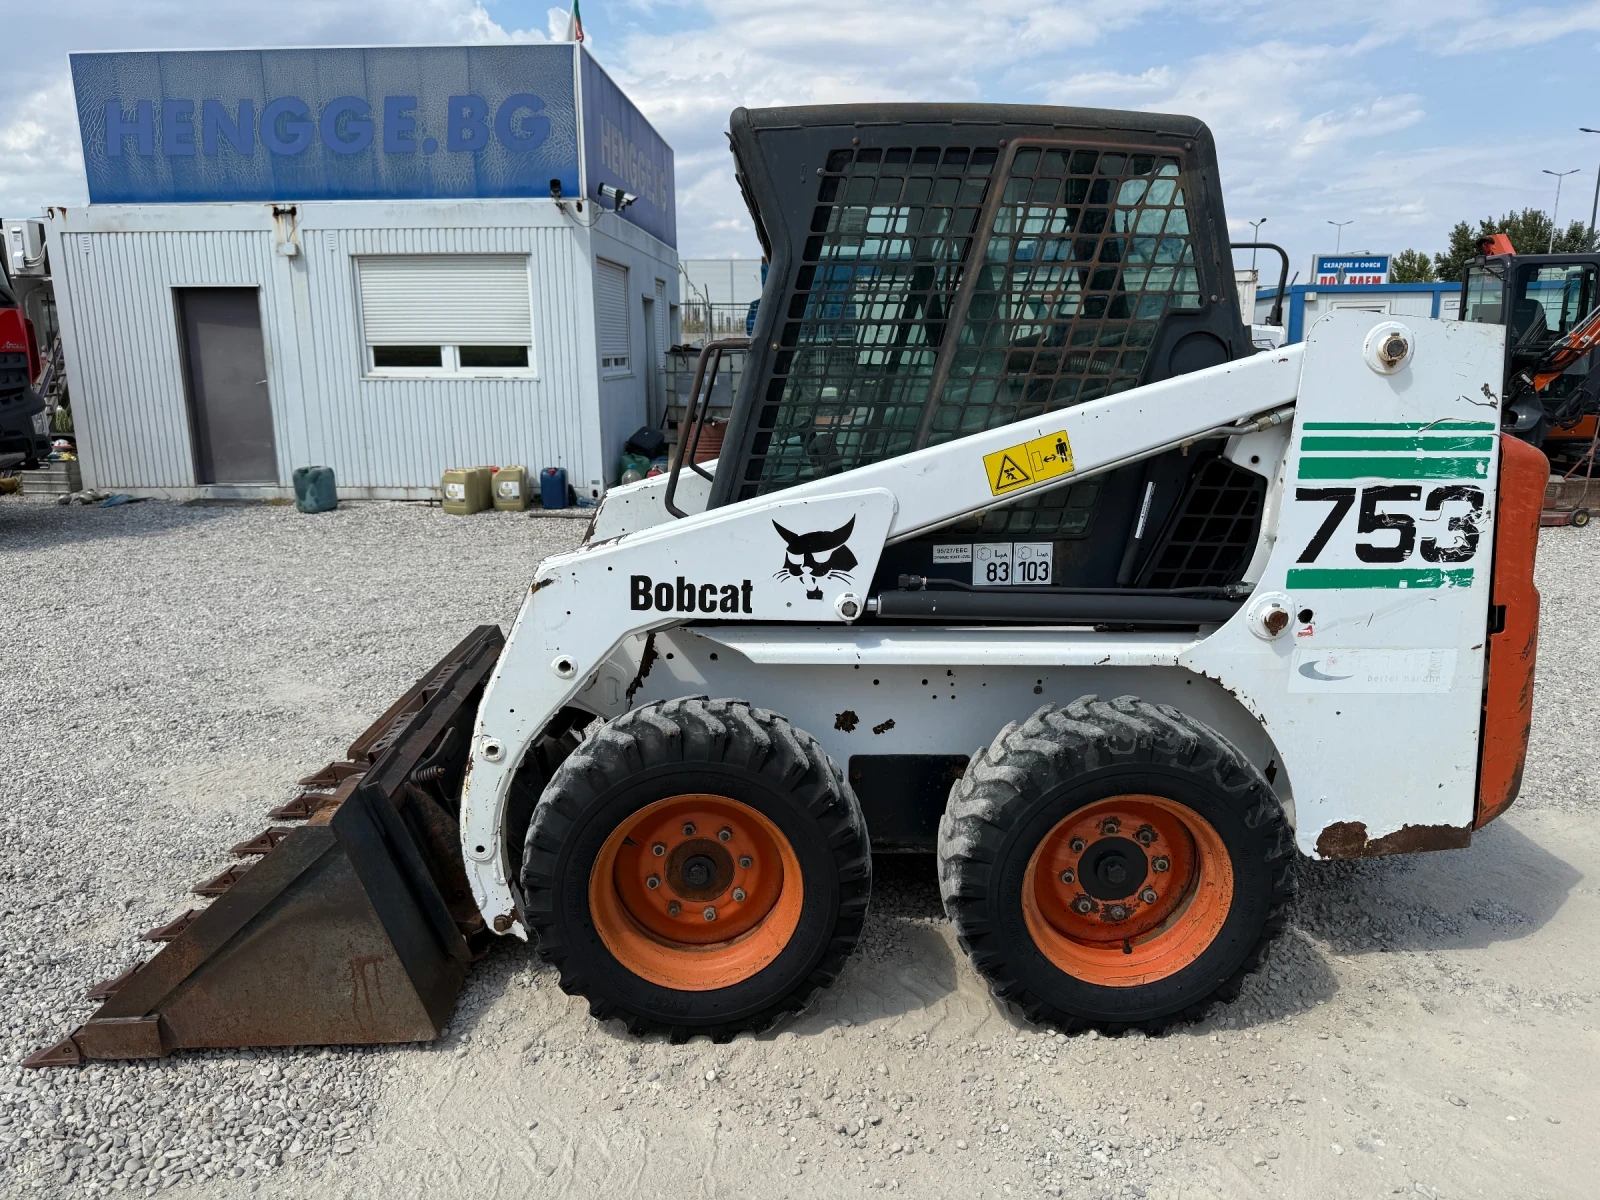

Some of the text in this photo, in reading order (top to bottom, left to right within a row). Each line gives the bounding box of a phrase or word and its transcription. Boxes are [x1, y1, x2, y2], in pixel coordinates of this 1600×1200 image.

[104, 94, 551, 157] HENGGE.BG
[1295, 485, 1485, 563] 753
[986, 562, 1009, 582] 83
[1018, 561, 1049, 581] 103
[630, 575, 753, 614] Bobcat
